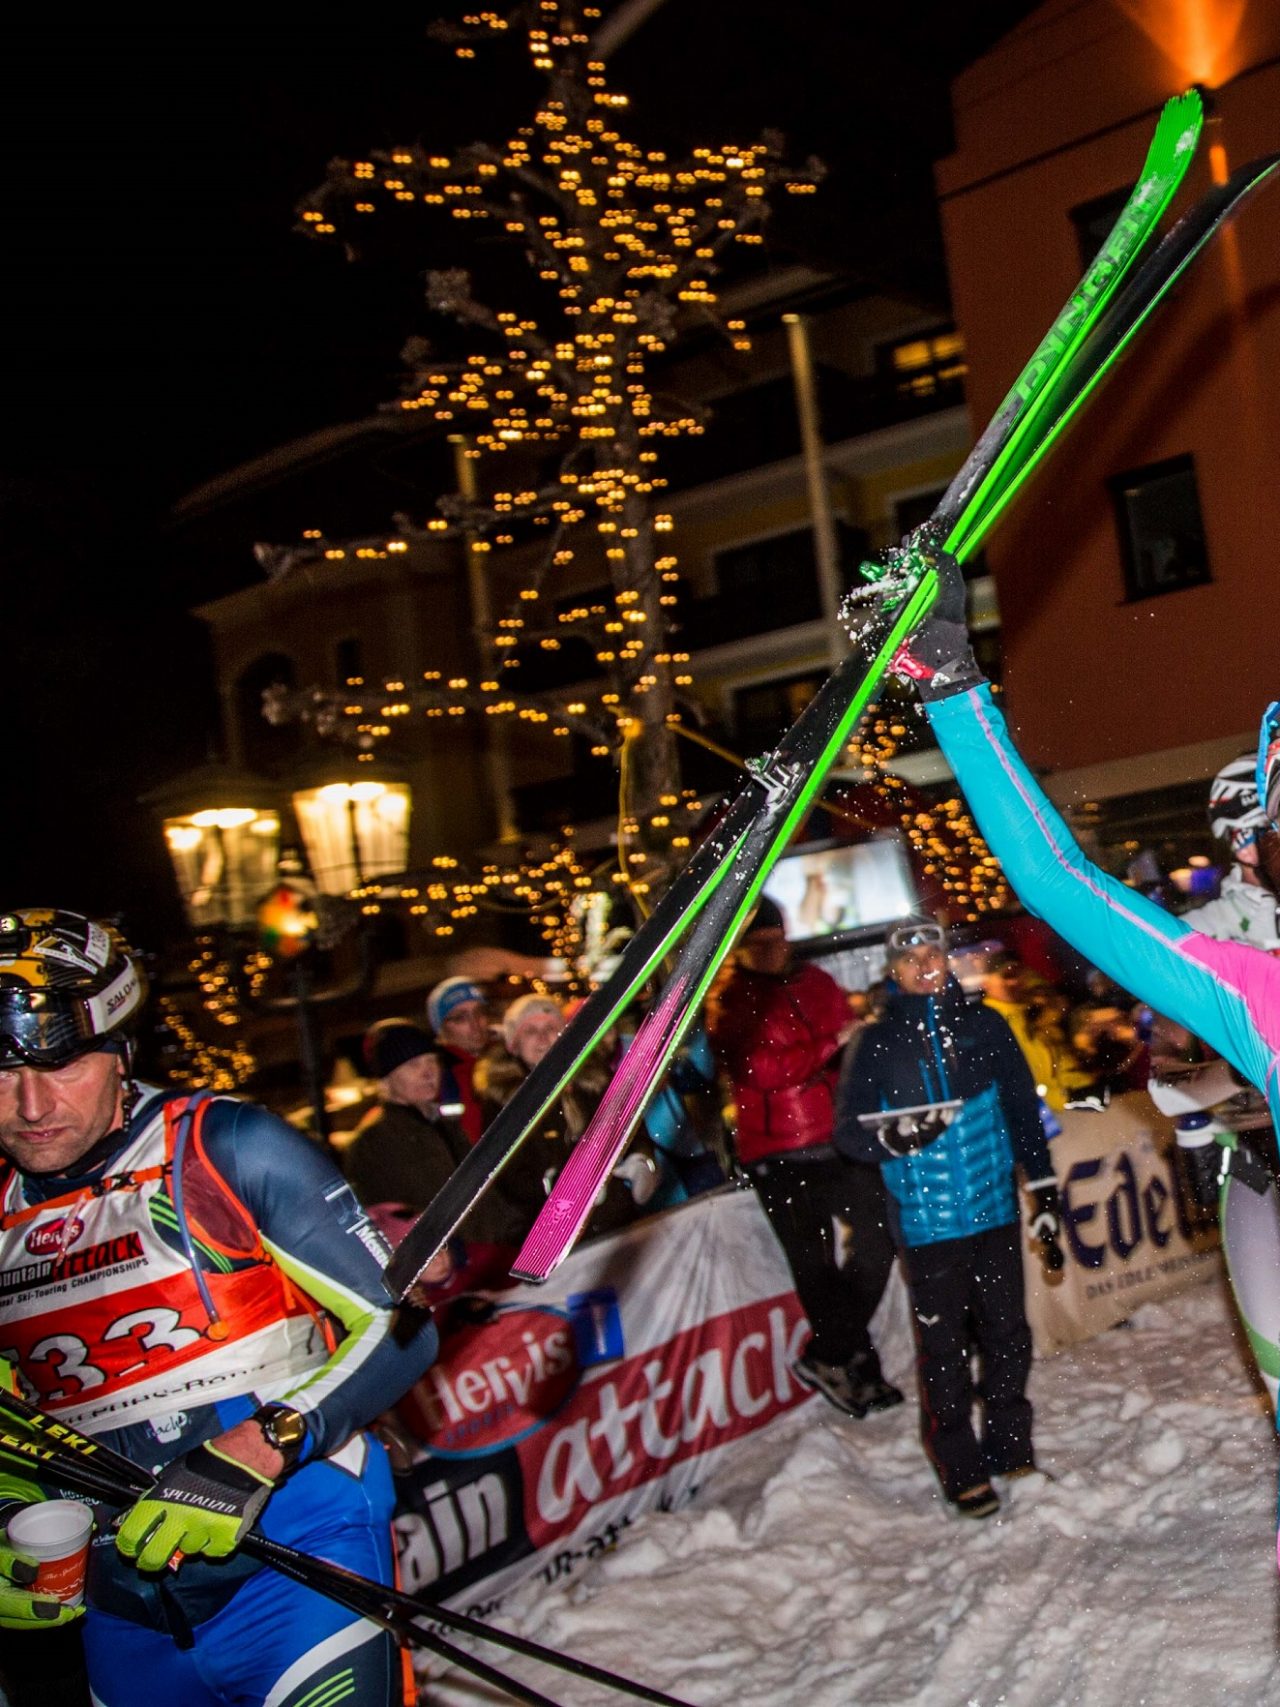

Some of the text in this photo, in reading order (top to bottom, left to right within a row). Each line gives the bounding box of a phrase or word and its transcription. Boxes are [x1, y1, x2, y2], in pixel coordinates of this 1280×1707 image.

[17, 1283, 68, 1304] Ski-Touring
[411, 1330, 573, 1432] Hervis
[536, 1307, 815, 1524] attack
[28, 1414, 99, 1456] LEKI
